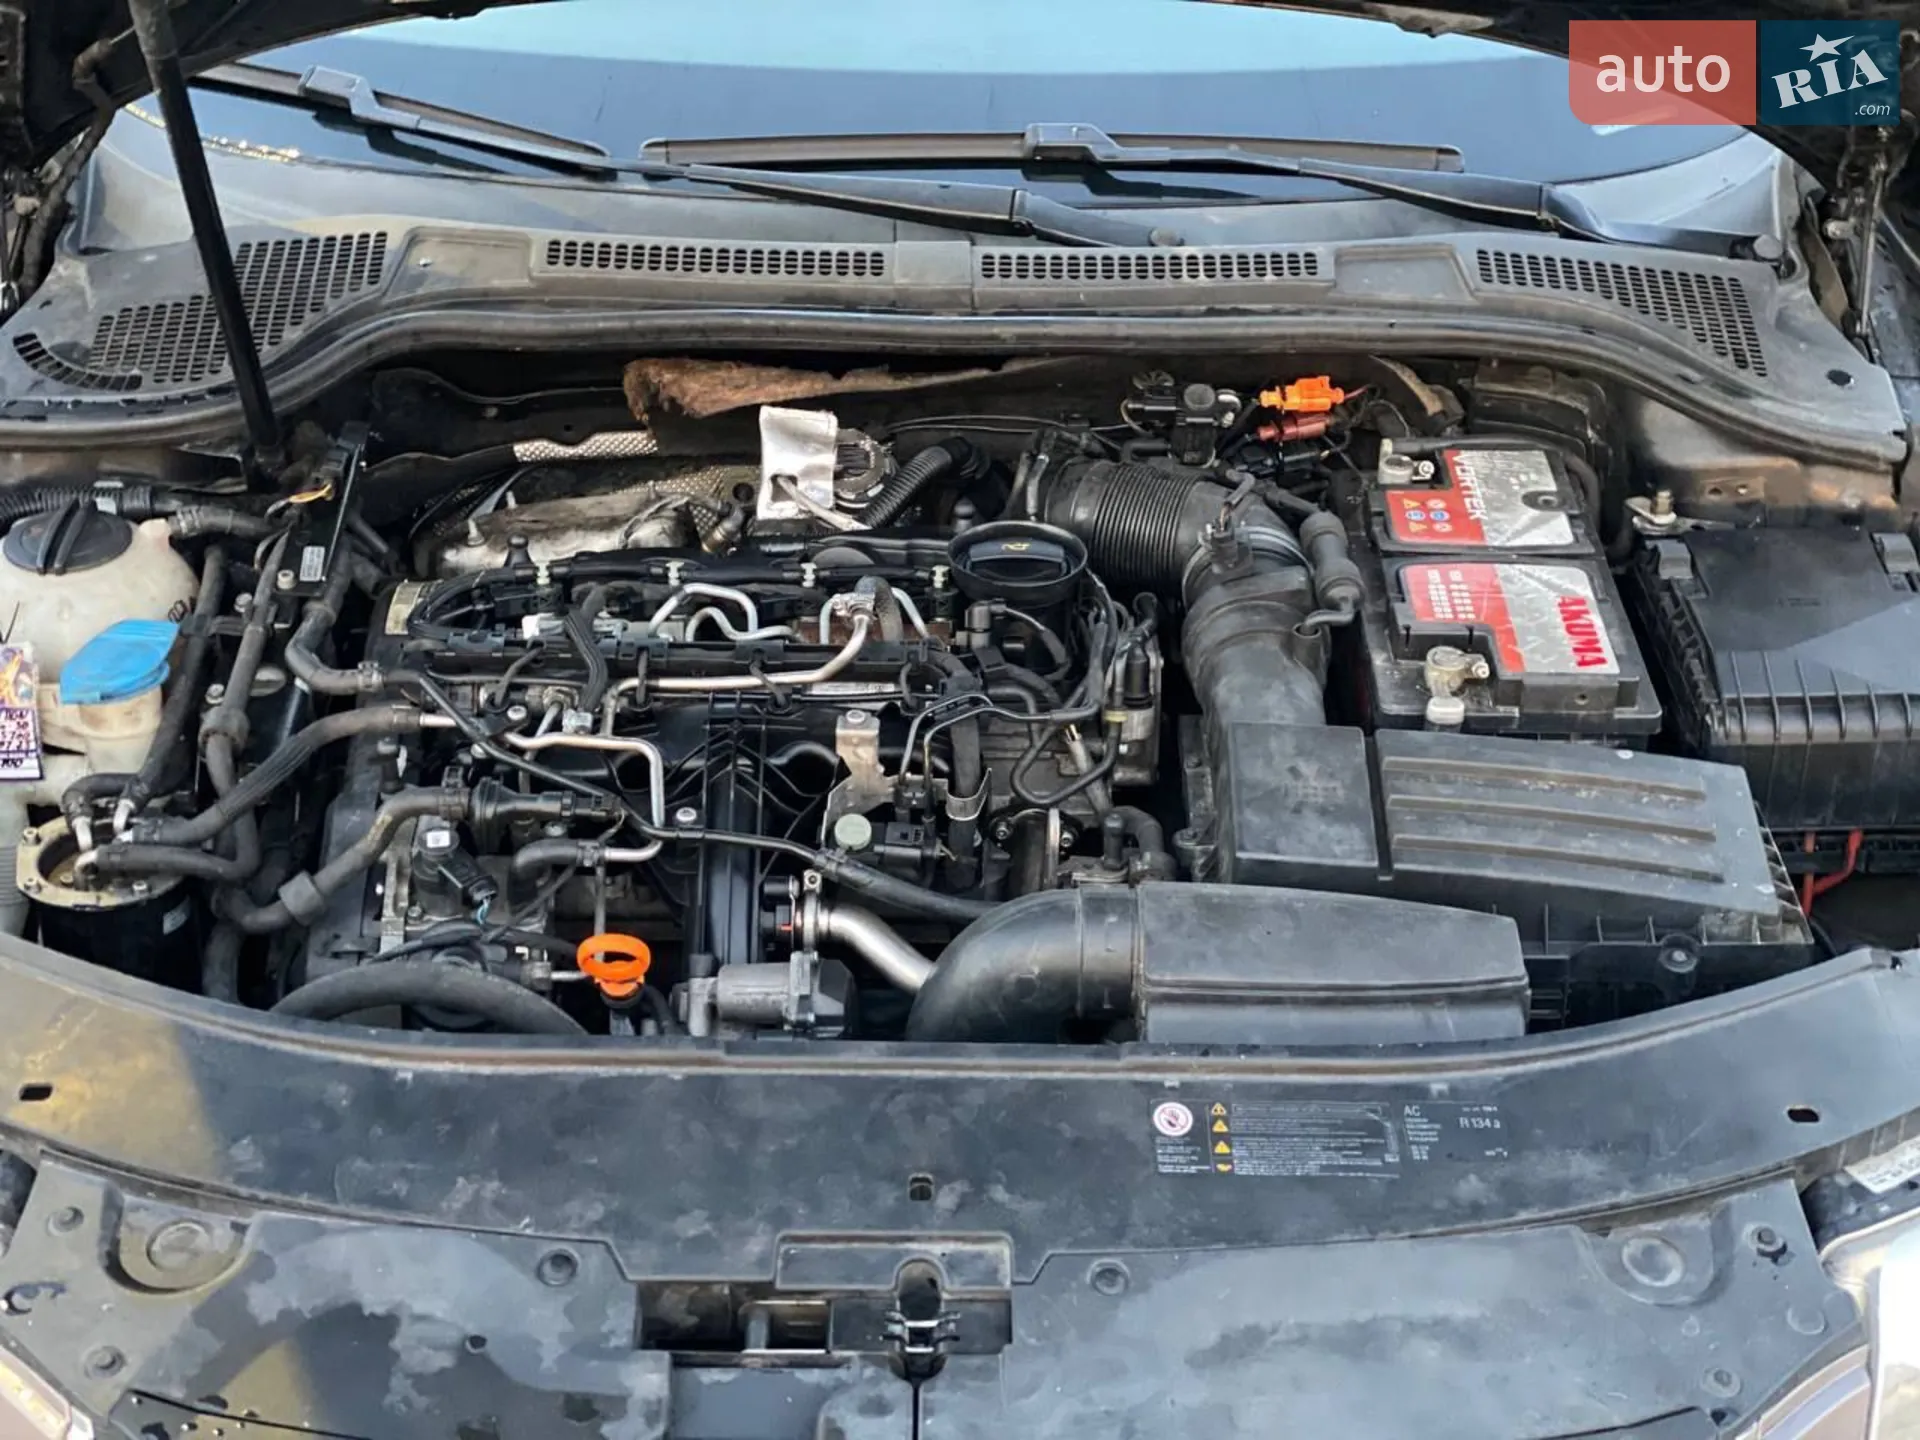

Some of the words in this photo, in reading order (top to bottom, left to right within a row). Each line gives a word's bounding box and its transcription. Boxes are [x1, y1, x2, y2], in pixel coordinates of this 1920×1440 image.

[1557, 595, 1608, 668] AKUMA
[1404, 1105, 1420, 1116] AC
[1460, 1117, 1469, 1128] R
